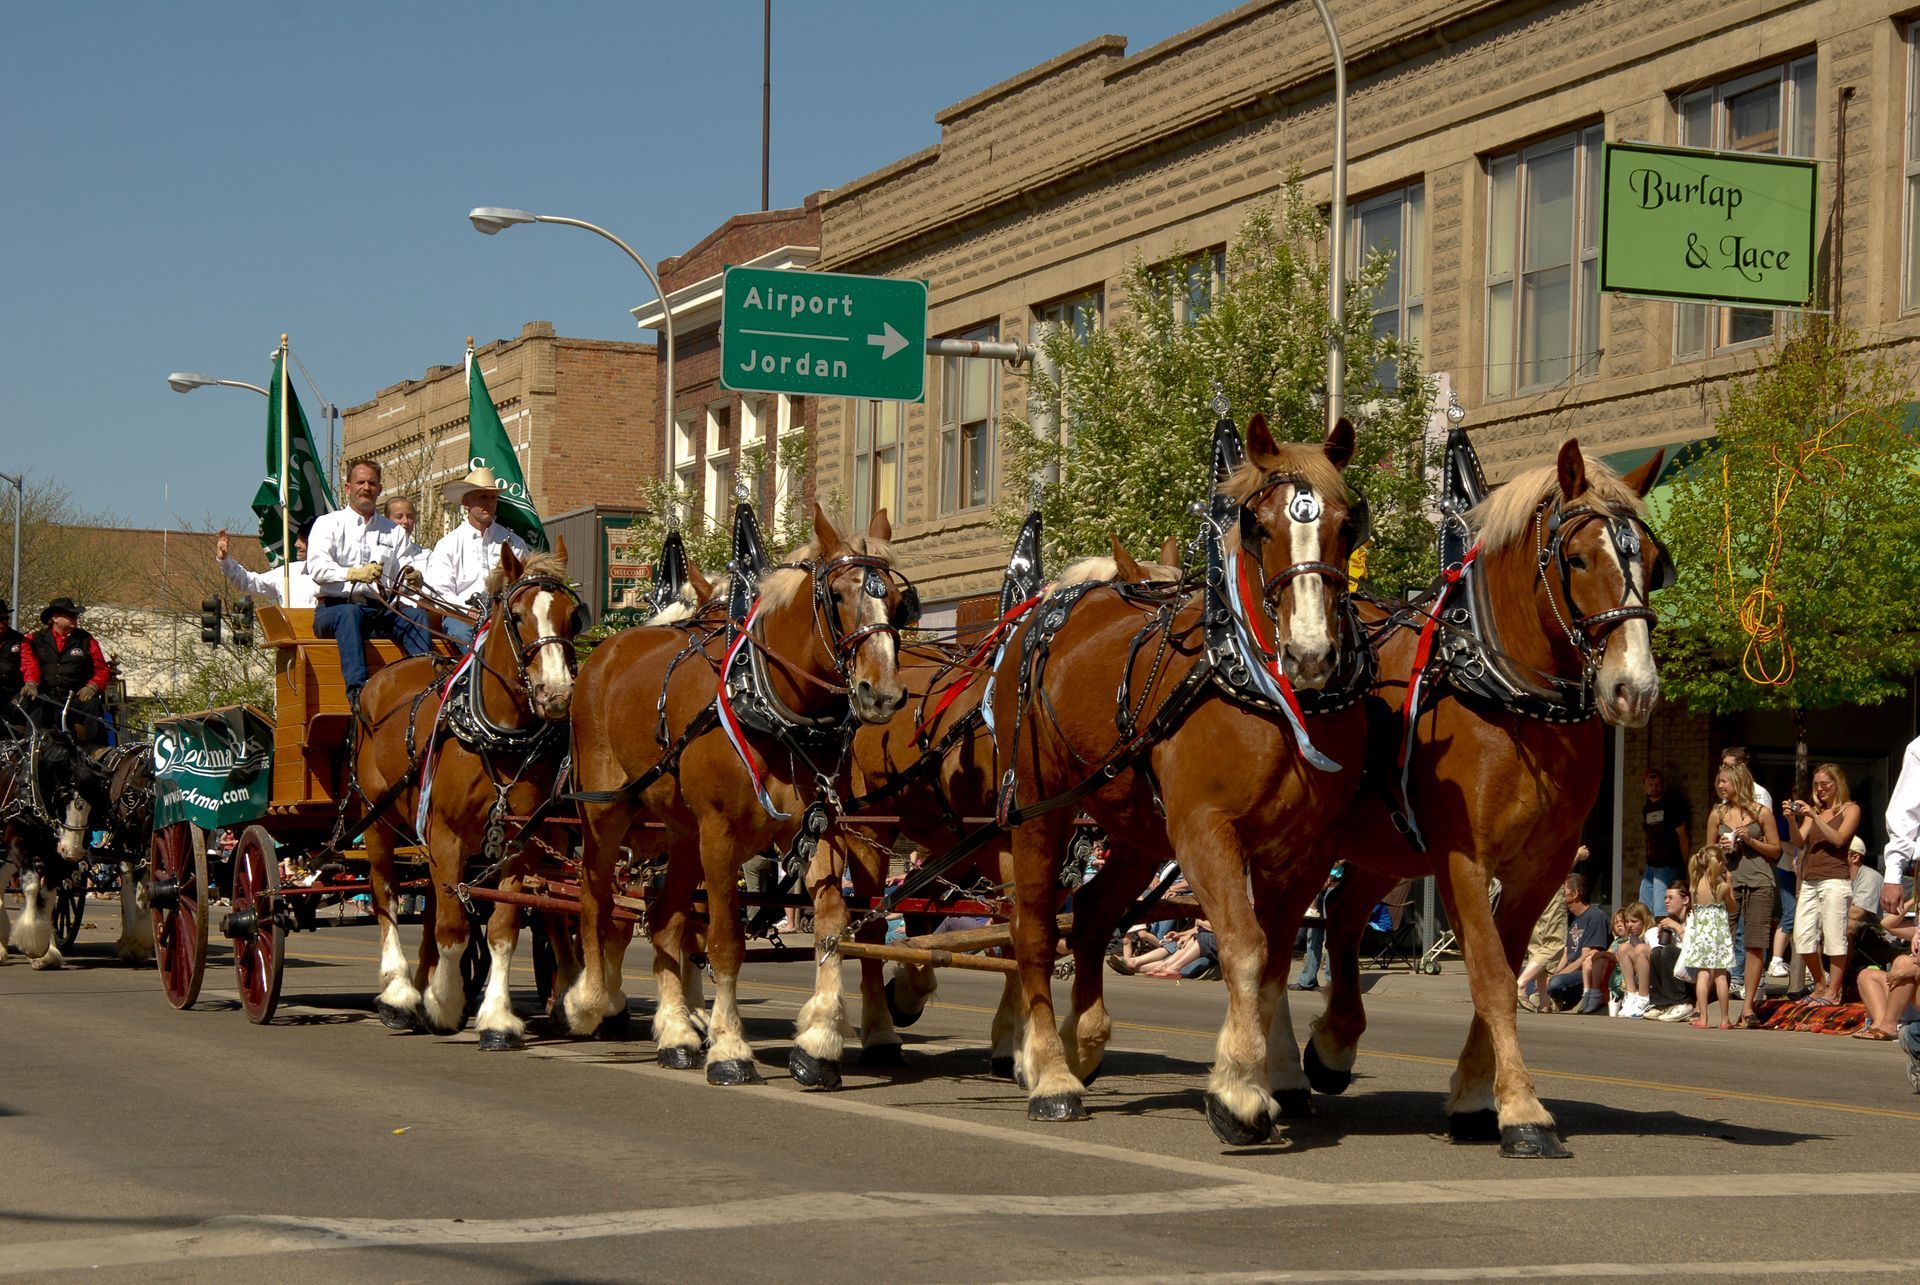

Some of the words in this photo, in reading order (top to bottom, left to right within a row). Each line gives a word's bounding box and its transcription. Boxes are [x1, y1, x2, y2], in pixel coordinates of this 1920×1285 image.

[1629, 168, 1743, 222] Burlap
[1685, 232, 1713, 270] &
[1719, 235, 1791, 283] Lace
[743, 286, 853, 318] Airport
[739, 350, 848, 379] Jordan
[613, 568, 647, 577] WELCOME
[604, 612, 631, 622] Miles
